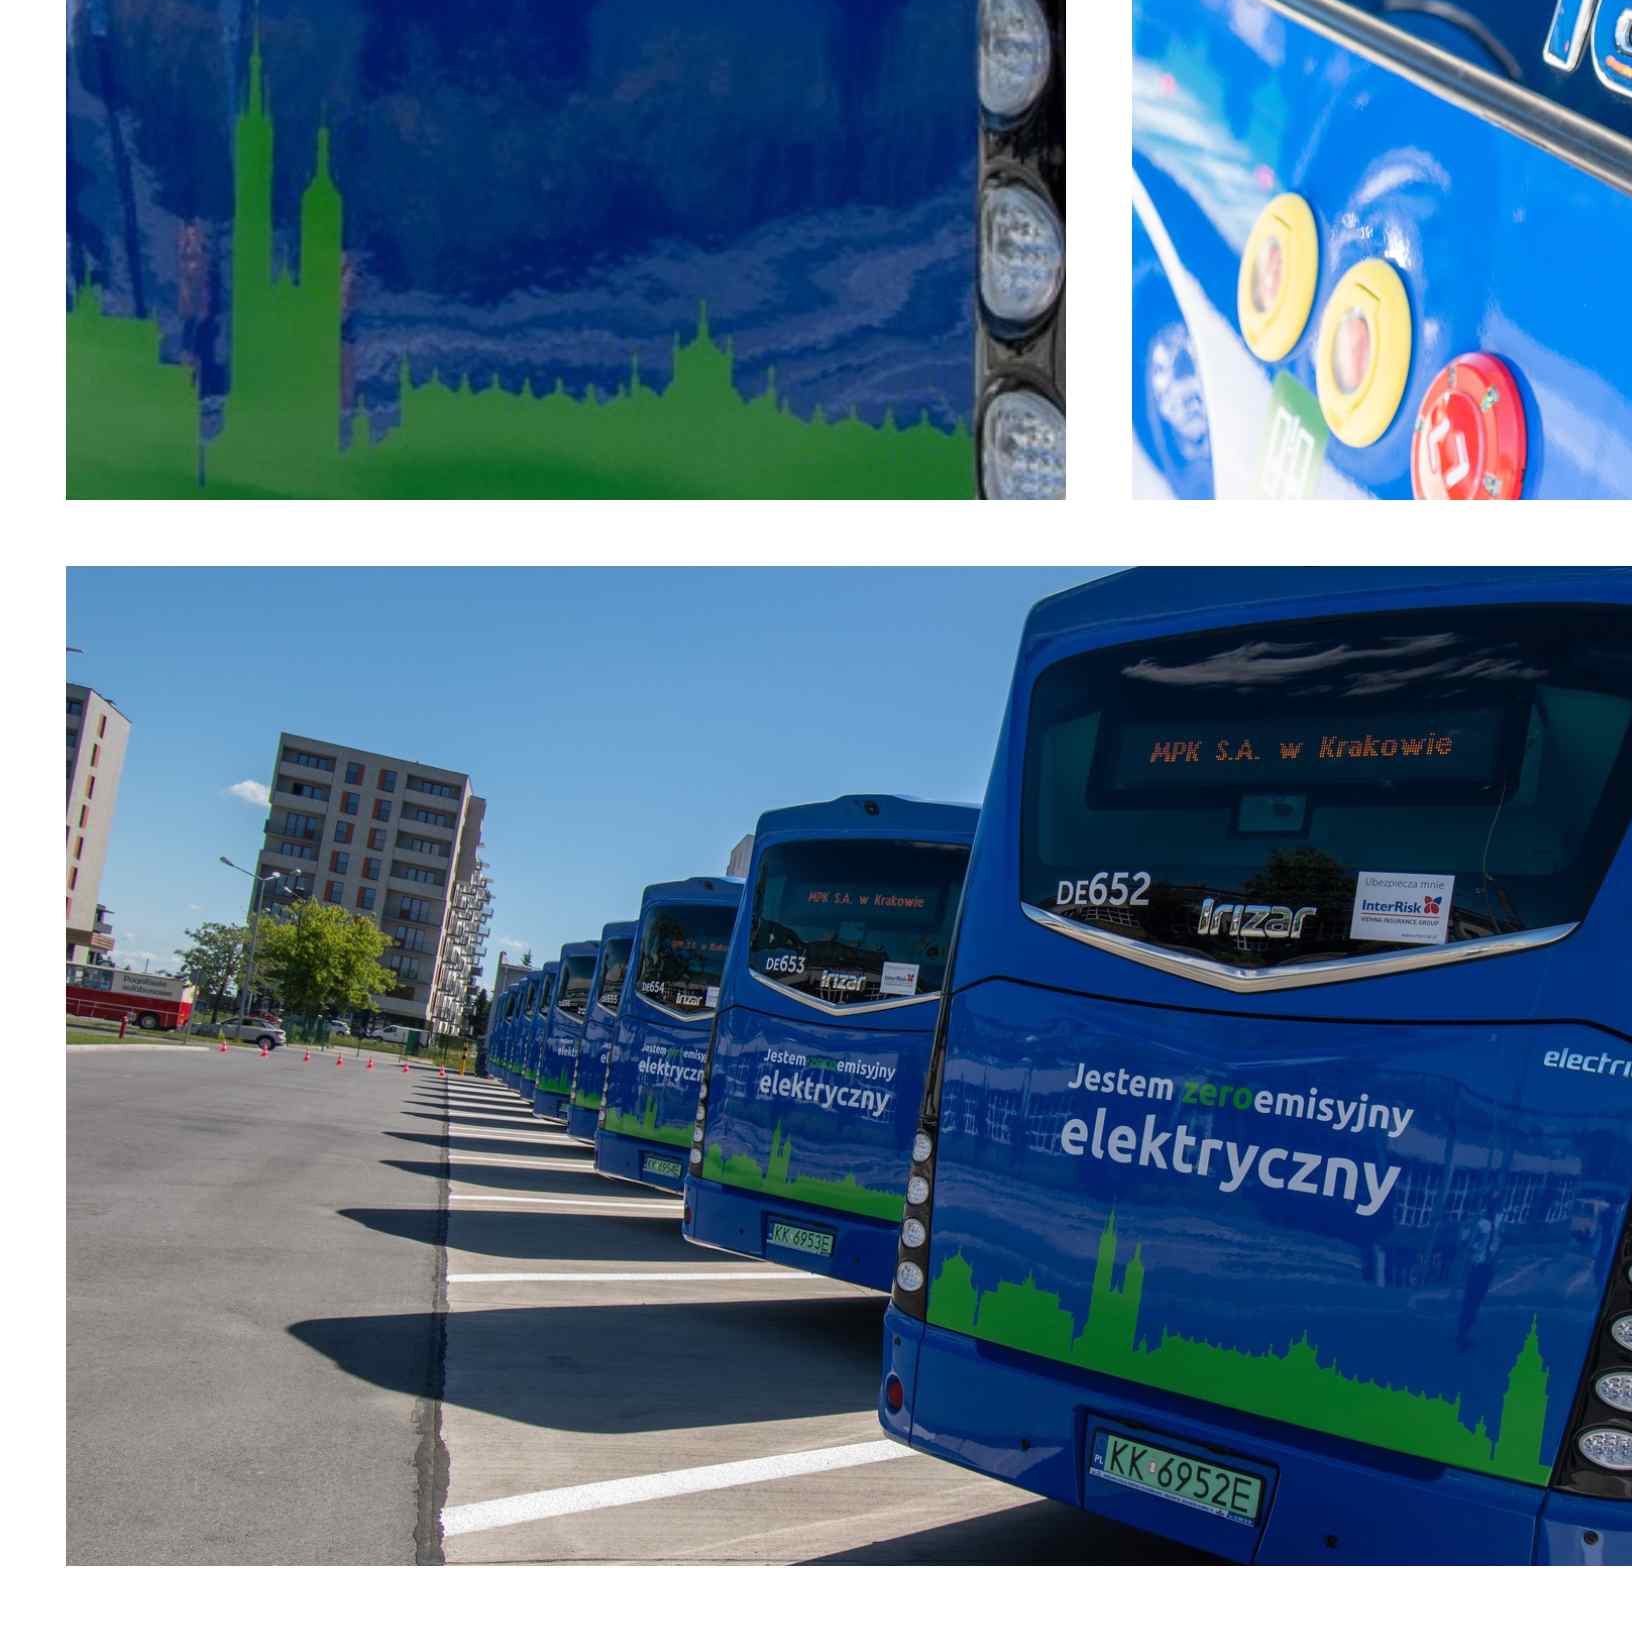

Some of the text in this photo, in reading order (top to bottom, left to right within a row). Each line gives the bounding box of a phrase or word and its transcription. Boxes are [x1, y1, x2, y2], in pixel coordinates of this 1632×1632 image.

[1150, 741, 1201, 763] MPK
[1279, 742, 1303, 759] w
[1318, 732, 1453, 760] Krakowie
[1056, 871, 1151, 906] DE652
[1361, 899, 1422, 914] InterRisk
[766, 955, 807, 974] DE653
[638, 1058, 706, 1083] elektryczn
[763, 1048, 806, 1066] Jestem
[760, 1069, 890, 1117] elektryczny
[1068, 1062, 1414, 1138] Jestem zeroemisyjny
[1061, 1107, 1402, 1217] elektryczny
[773, 1223, 832, 1254] KK 6953E
[1110, 1440, 1148, 1481] KK
[1157, 1457, 1253, 1513] 6952E
